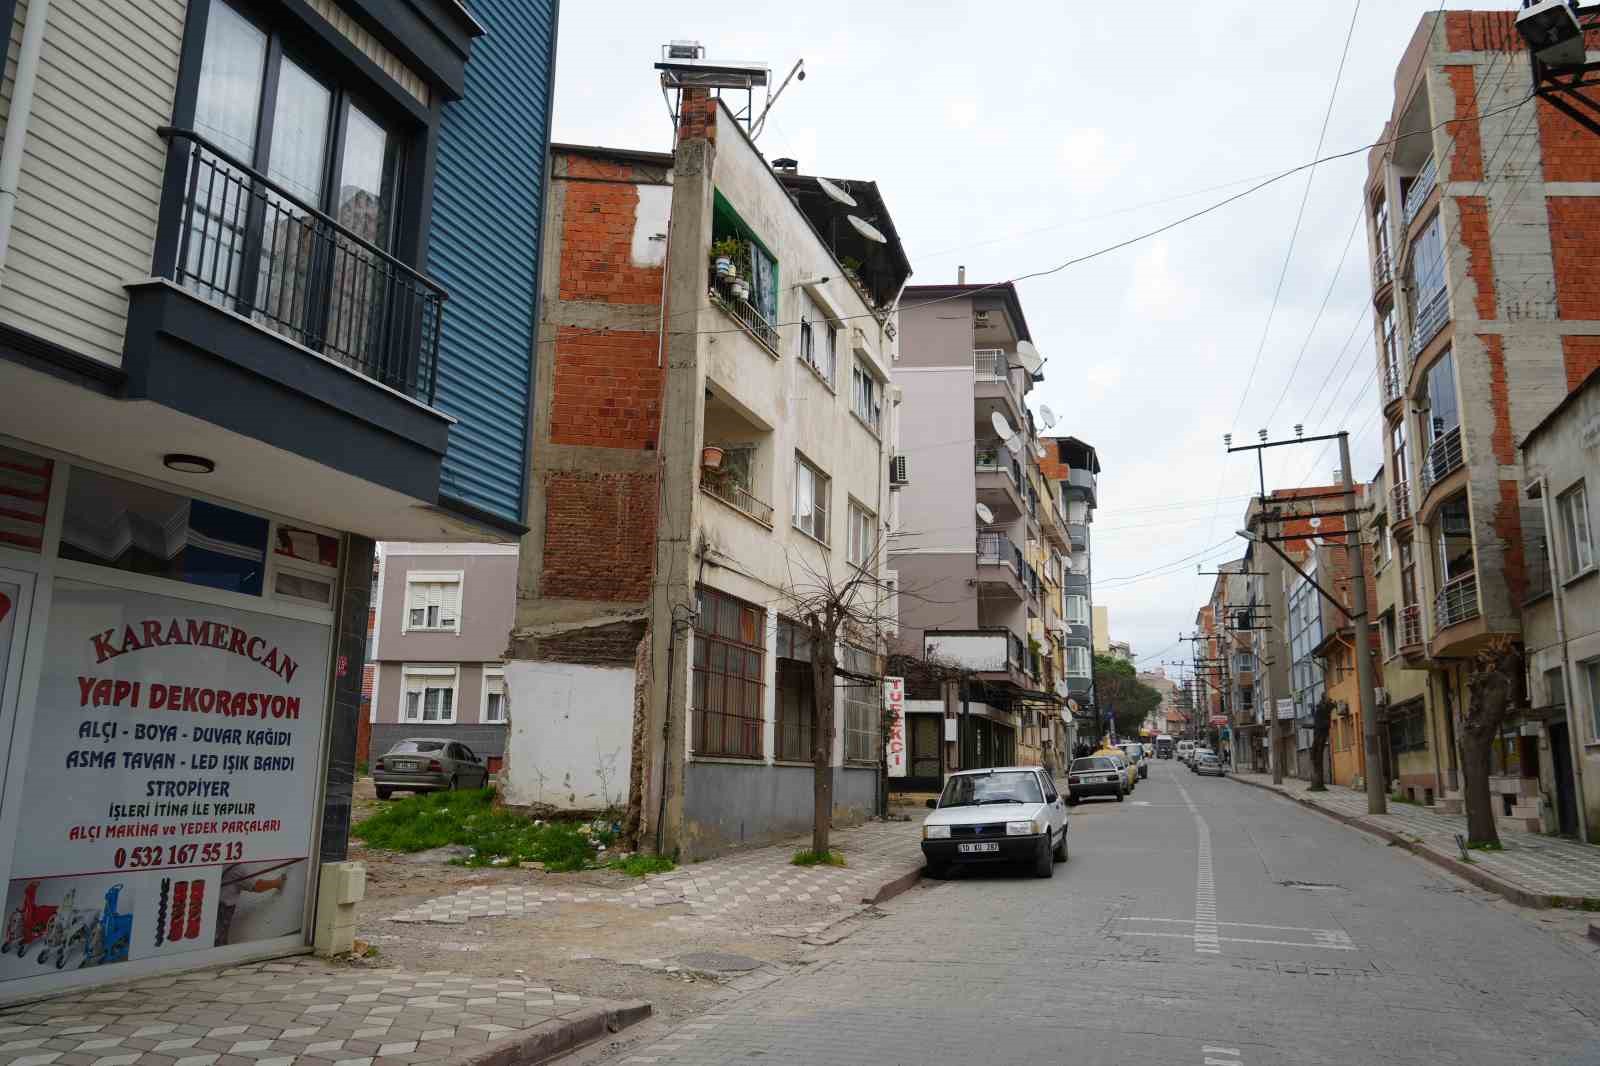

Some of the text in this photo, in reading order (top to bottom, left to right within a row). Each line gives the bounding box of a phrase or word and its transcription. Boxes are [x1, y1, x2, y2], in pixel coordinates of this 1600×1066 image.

[90, 618, 298, 684] KARAMERCAN
[77, 676, 301, 720] YAPI DEKORASYON
[79, 721, 117, 743] ALÇI
[134, 723, 178, 742] BOYA
[193, 727, 242, 745] DUVAR
[246, 728, 291, 746] KAĞIDI
[65, 750, 116, 770] ASMA
[123, 752, 176, 770] TAVAN
[191, 754, 218, 770] LED
[223, 755, 249, 774] IŞIK
[253, 756, 295, 771] BANDI
[146, 777, 230, 798] STROPİYER
[108, 801, 256, 821] İŞLERİ İTİNA İLE YAPILIR
[69, 819, 281, 843] ALÇI MAKİNA ve YEDEK PARÇALARI
[114, 841, 244, 868] 0 532 167 55 13
